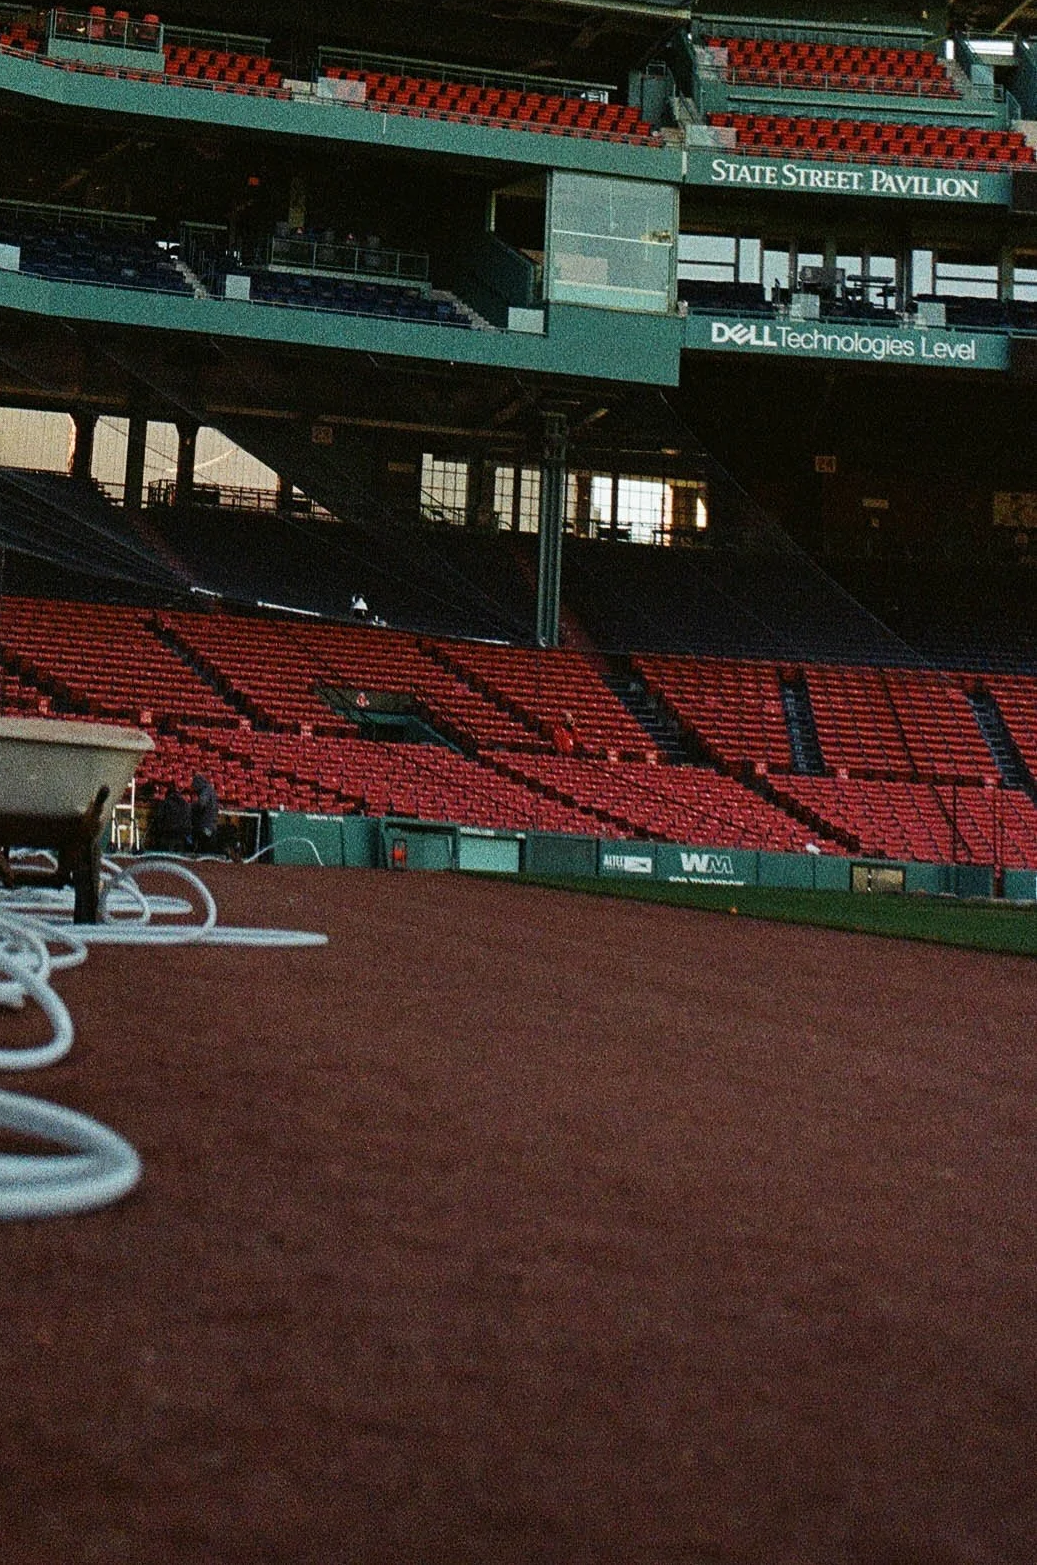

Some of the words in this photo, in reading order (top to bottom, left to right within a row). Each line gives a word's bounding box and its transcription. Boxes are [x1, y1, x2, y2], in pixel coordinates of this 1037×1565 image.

[711, 158, 778, 185] STATE
[870, 169, 980, 199] PAVILION
[711, 321, 777, 347] DELL
[776, 326, 915, 360] Technologies
[921, 336, 976, 361] Level
[680, 852, 735, 875] WM
